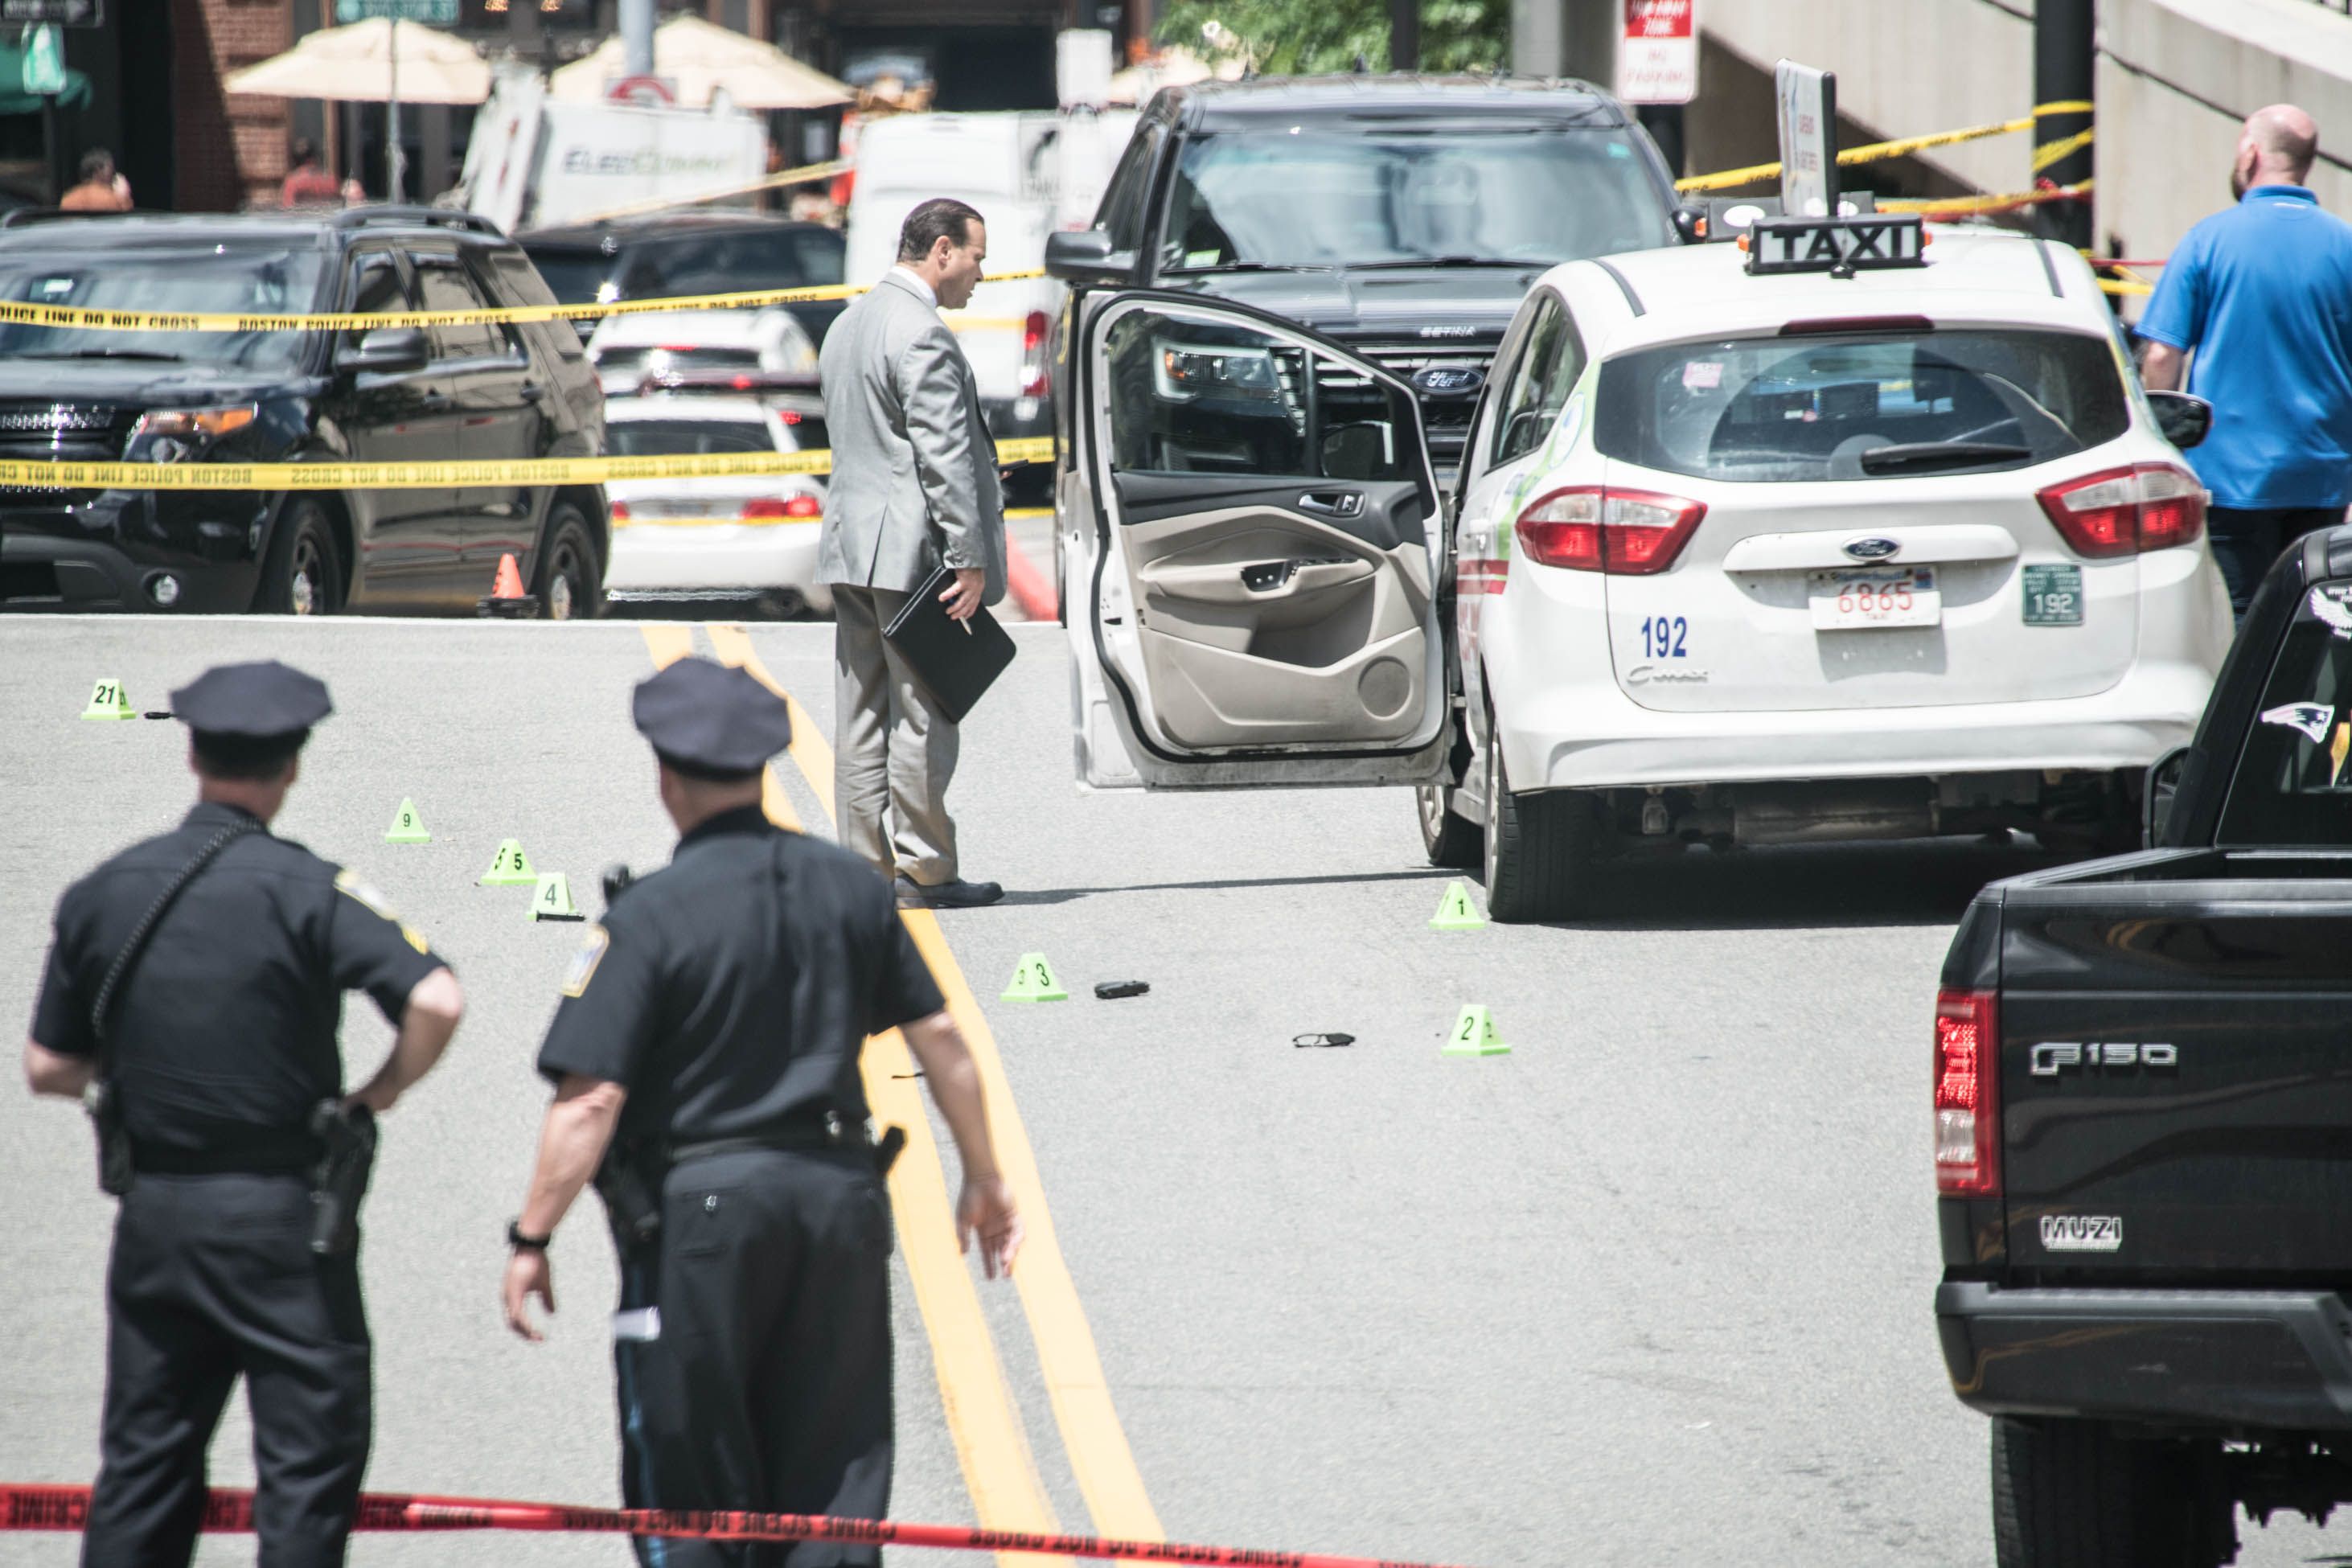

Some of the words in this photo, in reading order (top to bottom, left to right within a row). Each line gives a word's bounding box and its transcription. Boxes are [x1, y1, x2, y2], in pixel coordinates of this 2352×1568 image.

[1772, 227, 1903, 261] TAXI
[84, 312, 105, 324] DO
[112, 314, 141, 326] NOT
[1839, 581, 1913, 613] 6865
[2033, 593, 2073, 614] 192
[1642, 617, 1687, 657] 192
[94, 685, 115, 704] 21
[403, 814, 411, 827] 9
[514, 852, 523, 870] 5
[544, 883, 556, 905] 4
[1458, 898, 1464, 915] 1
[1036, 963, 1049, 987] 3
[1460, 1016, 1474, 1040] 2
[2042, 1217, 2121, 1241] MUZI
